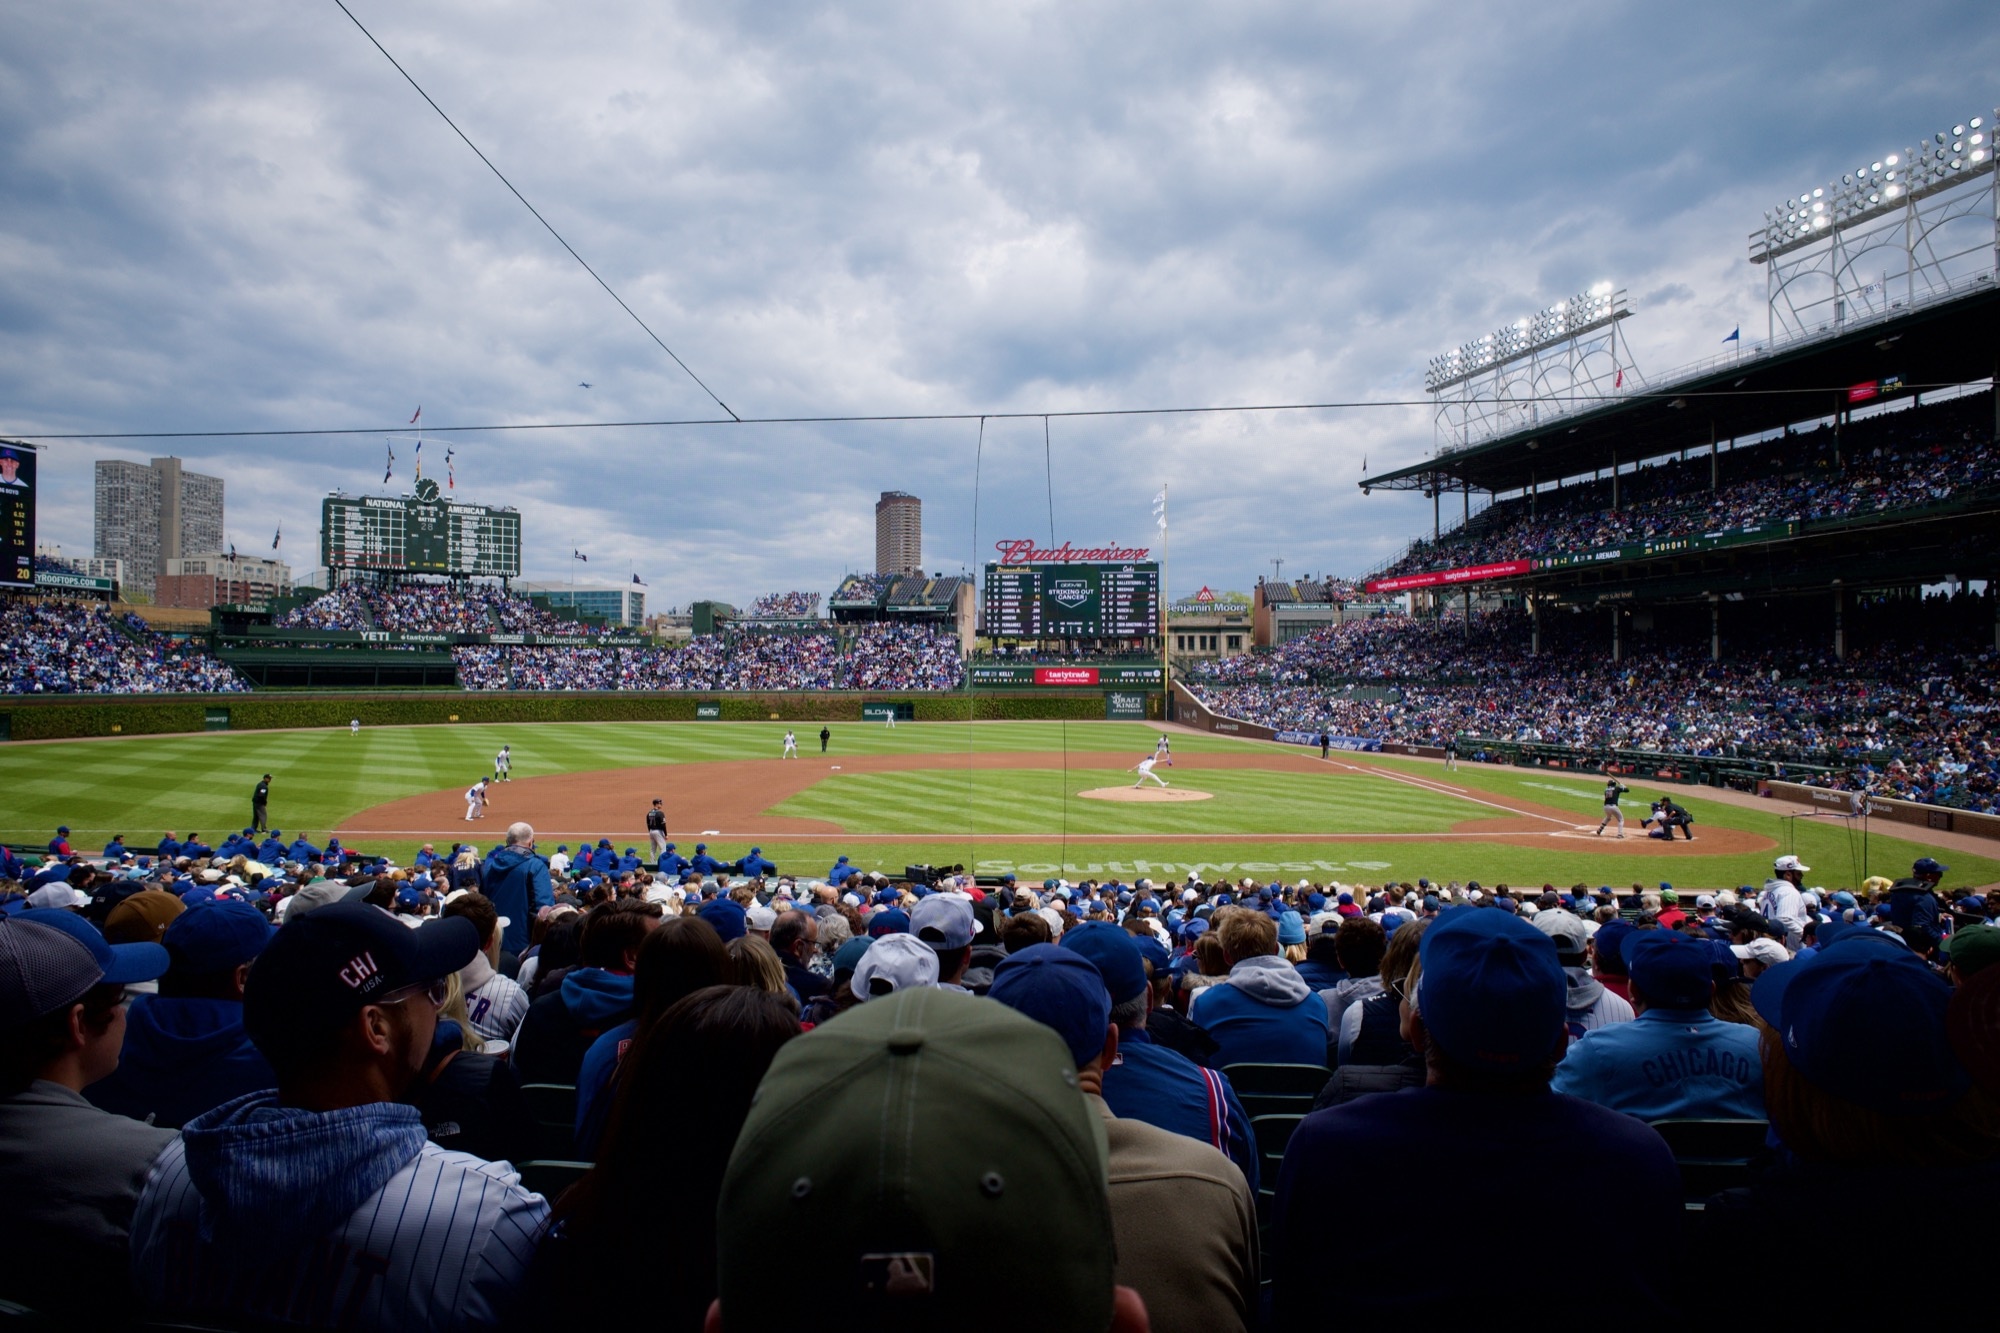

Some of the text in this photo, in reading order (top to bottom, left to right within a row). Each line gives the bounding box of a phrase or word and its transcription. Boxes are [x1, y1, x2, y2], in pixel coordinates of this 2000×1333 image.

[366, 499, 406, 509] NATIONAL
[447, 505, 486, 515] AMERICAN
[1684, 540, 1687, 548] 1
[996, 539, 1150, 564] Budweiser
[1596, 550, 1621, 560] ARENADO
[17, 568, 30, 579] 20
[1445, 570, 1470, 581] tastytrade
[1377, 581, 1398, 590] tastytrade
[244, 605, 266, 613] Mobile
[1167, 603, 1247, 614] Benjamin Moore
[360, 632, 390, 641] YETI
[406, 634, 447, 642] tastytrade
[1049, 671, 1090, 679] tastytrade
[699, 708, 717, 716] Hefty
[975, 859, 1346, 875] Southwest
[340, 952, 377, 987] CHI
[363, 976, 382, 992] USA
[1642, 1048, 1748, 1087] CHICAGO
